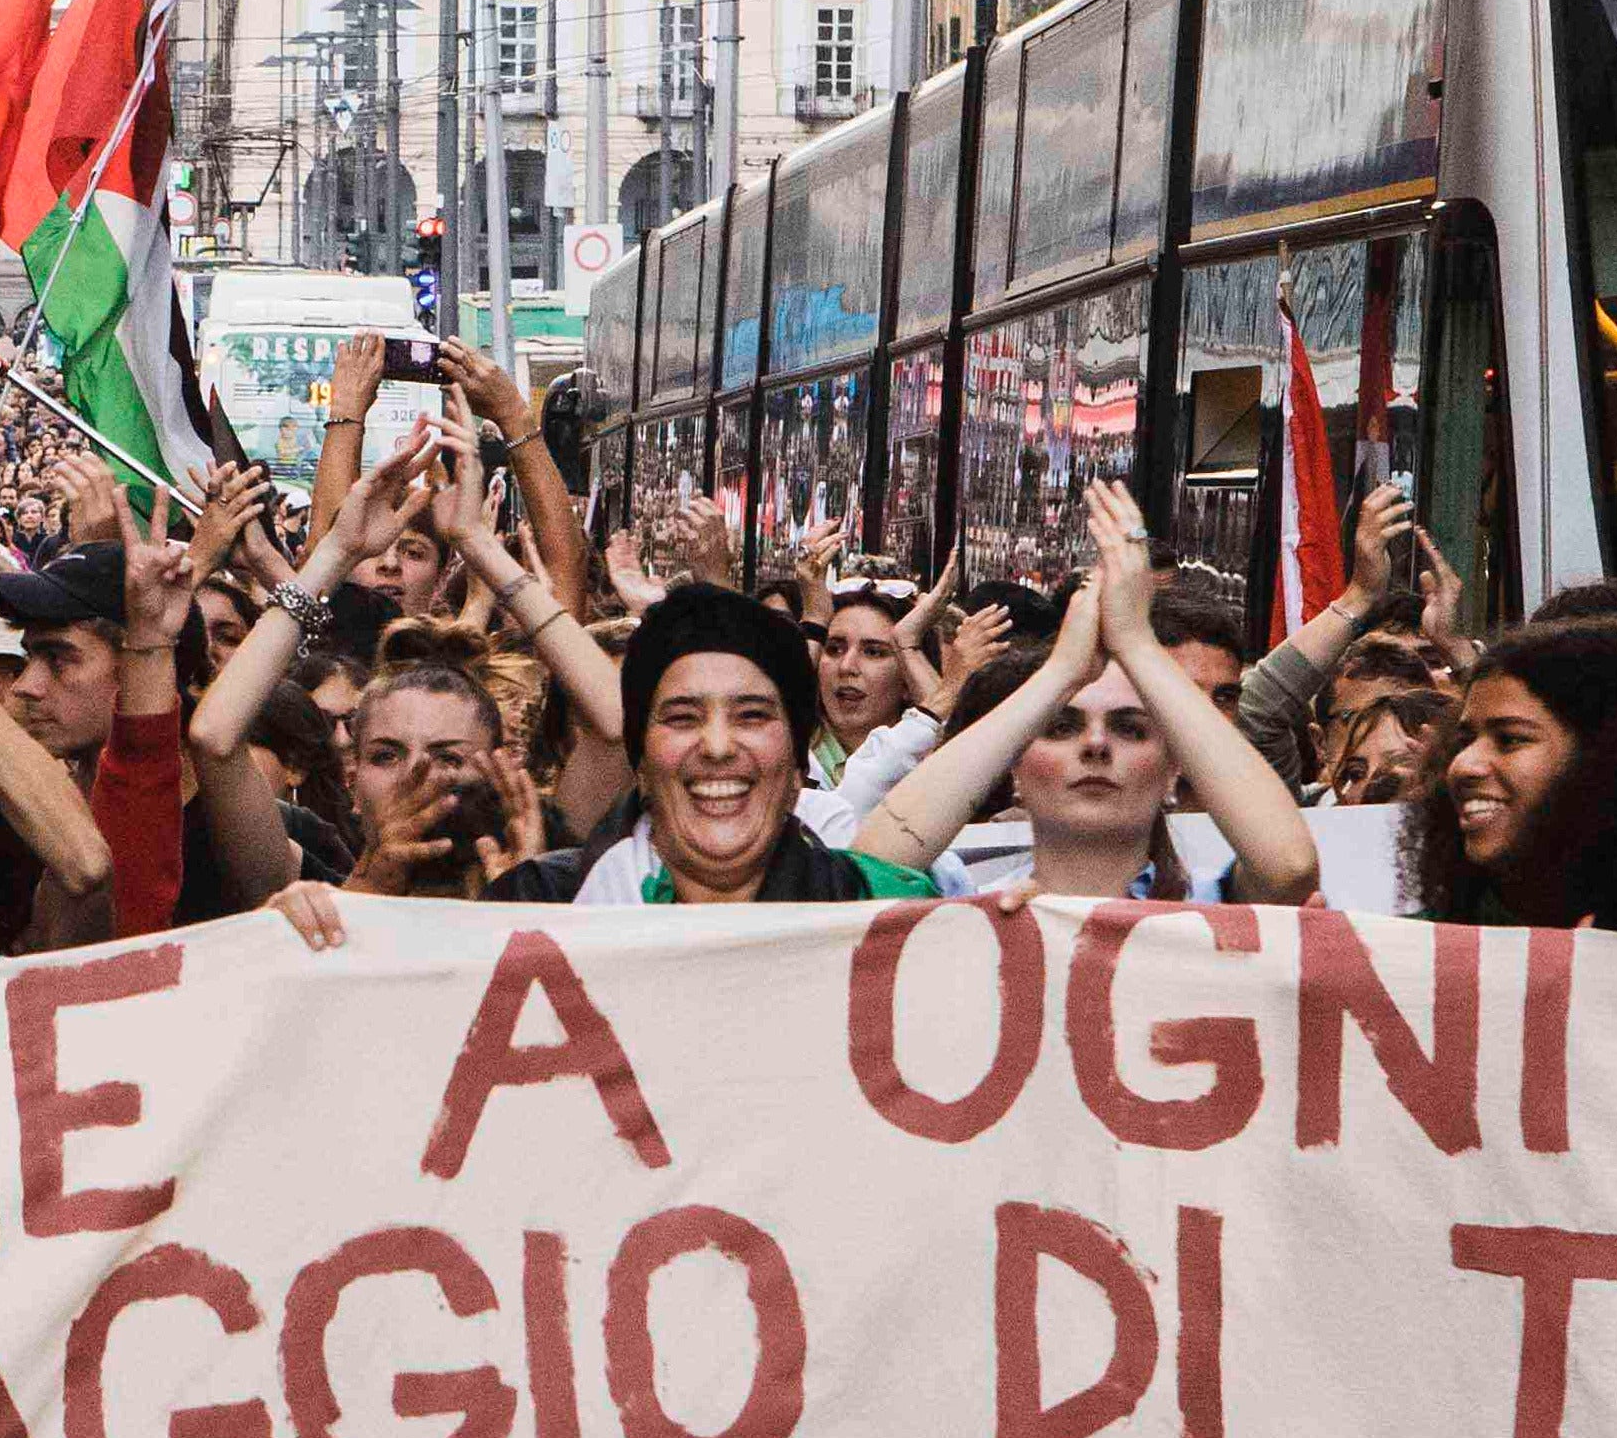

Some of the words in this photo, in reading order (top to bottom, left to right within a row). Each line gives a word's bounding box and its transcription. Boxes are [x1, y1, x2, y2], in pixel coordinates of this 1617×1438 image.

[251, 336, 333, 362] RESP
[420, 929, 672, 1181] A
[847, 895, 1576, 1155] OGNI
